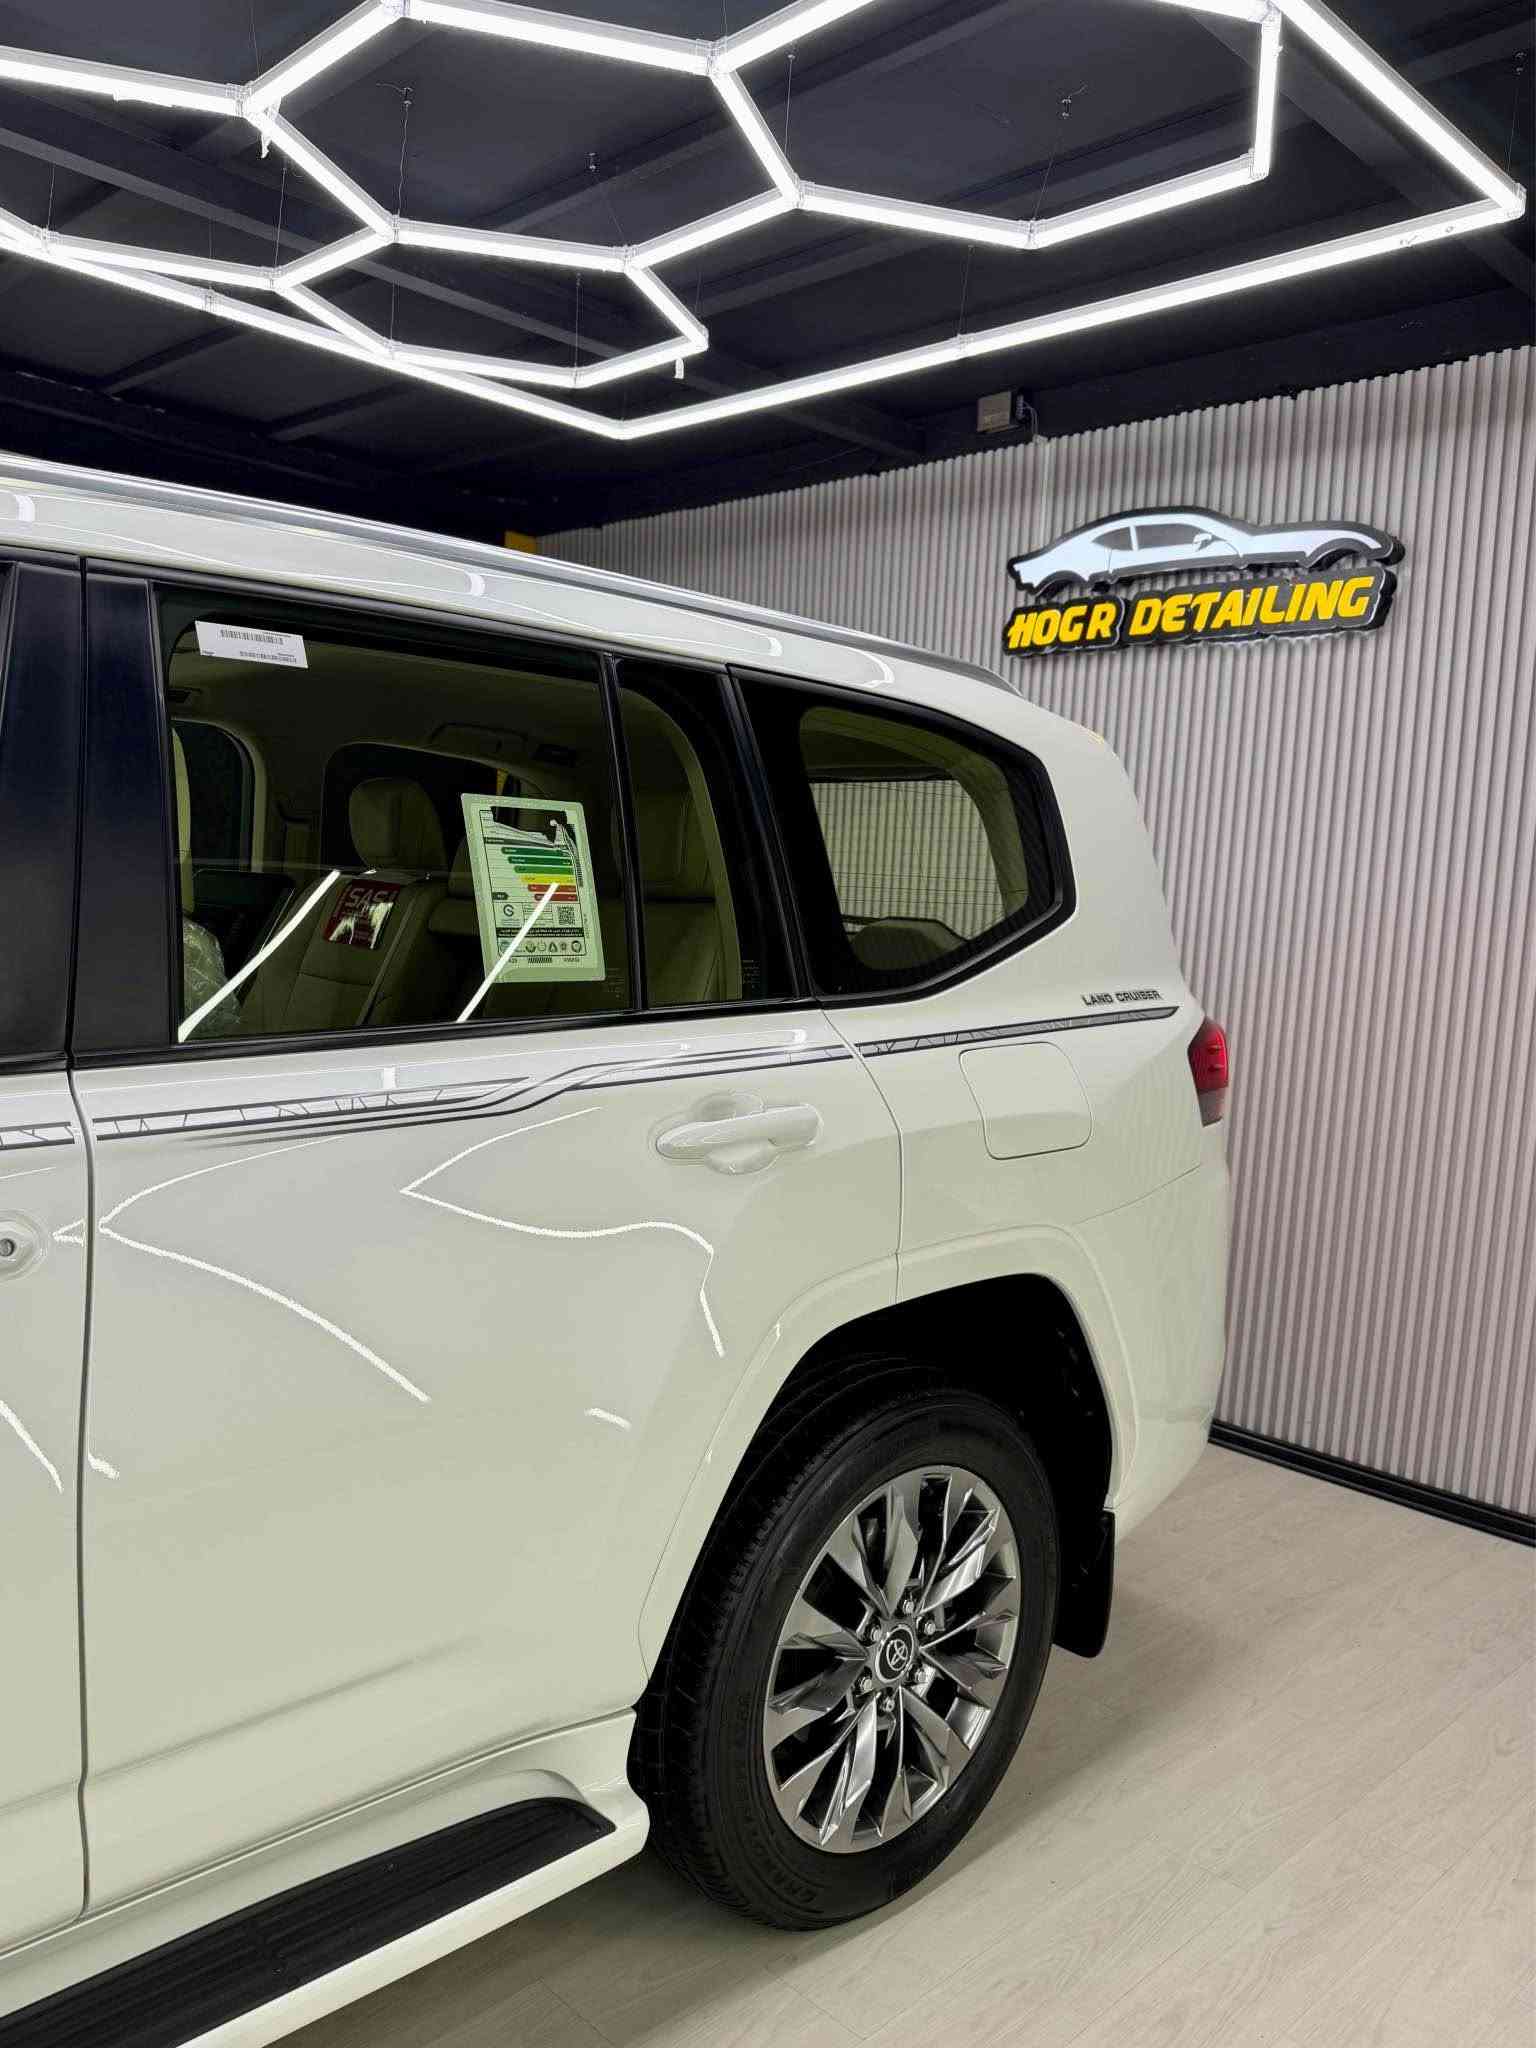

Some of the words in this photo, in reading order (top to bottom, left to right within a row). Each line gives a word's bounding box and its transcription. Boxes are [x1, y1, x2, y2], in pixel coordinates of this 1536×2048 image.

[1007, 602, 1116, 648] HOGR
[1128, 575, 1373, 635] DETAILING
[1082, 993, 1113, 1006] LAND
[1115, 990, 1162, 1003] CRUISER
